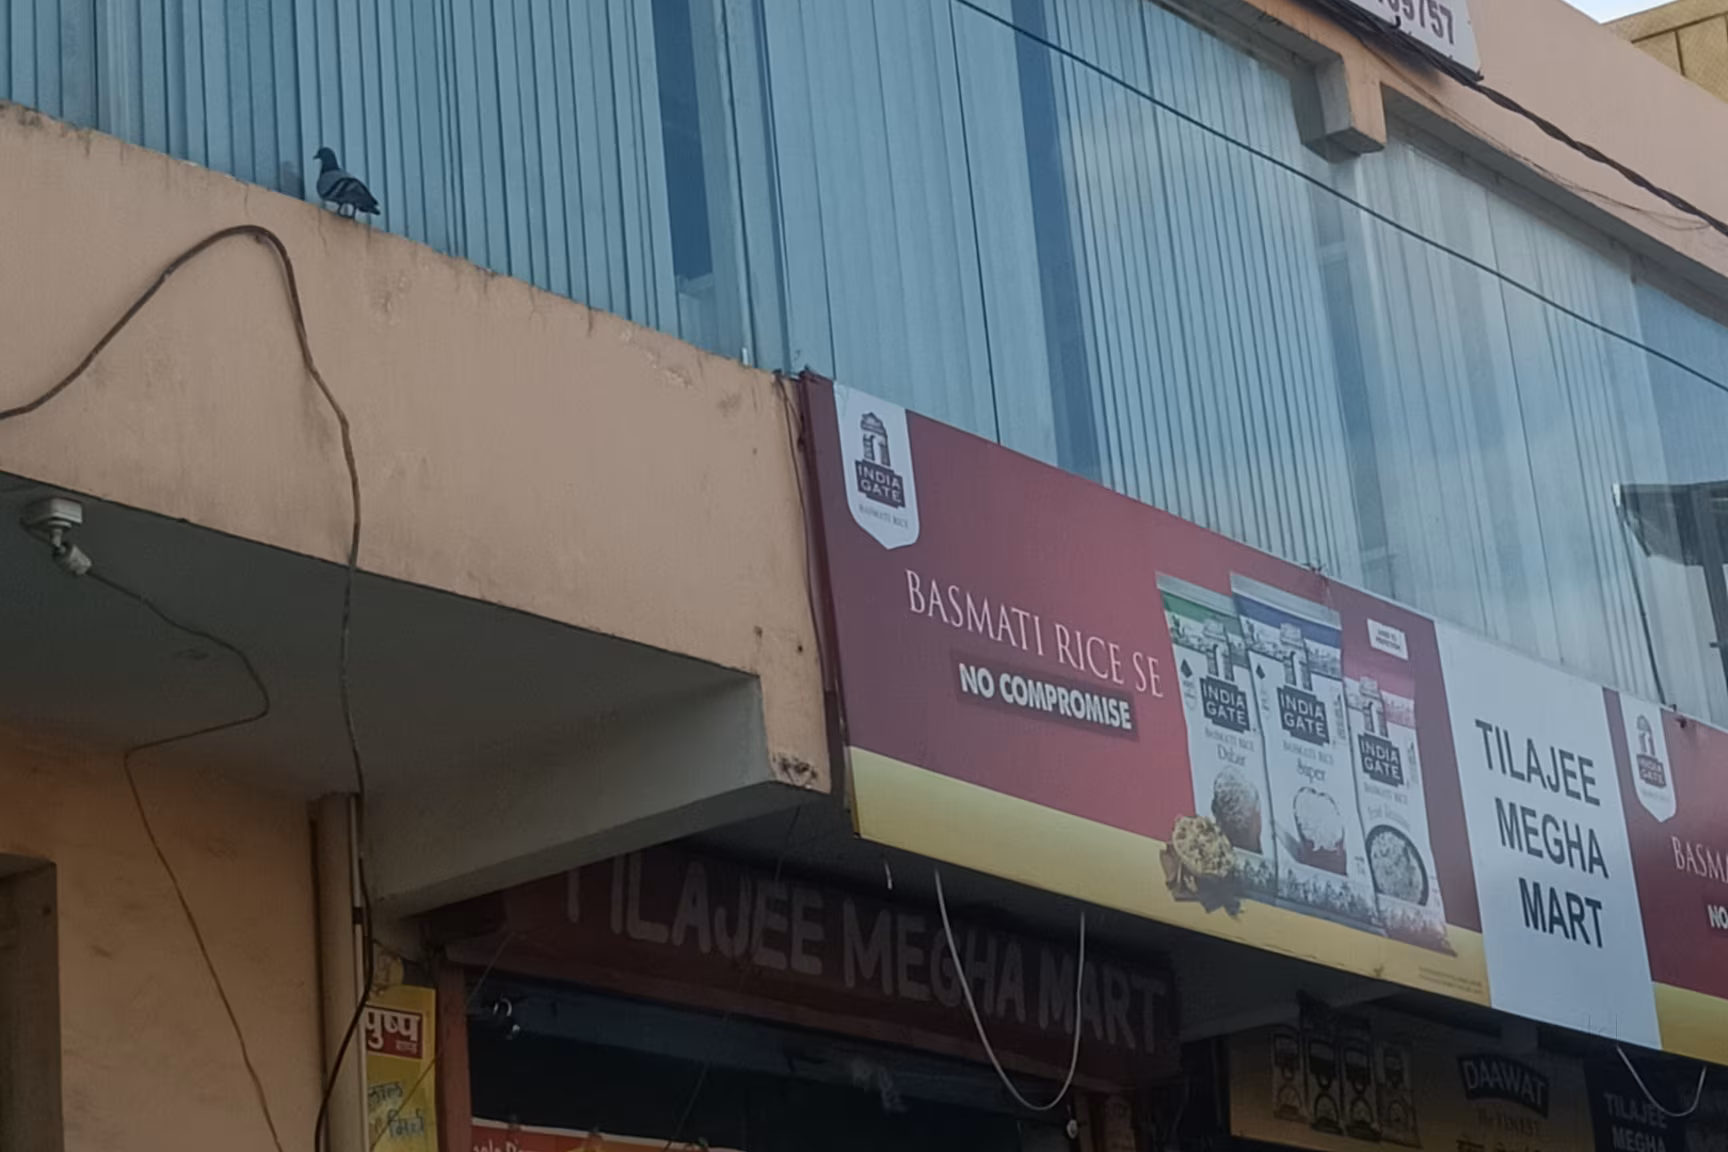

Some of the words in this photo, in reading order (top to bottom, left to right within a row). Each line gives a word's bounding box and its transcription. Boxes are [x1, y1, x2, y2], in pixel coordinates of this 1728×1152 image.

[858, 463, 901, 490] INDIA
[860, 479, 902, 504] GATE
[905, 569, 1046, 656] BASMATI
[1055, 623, 1125, 686] RICE
[1132, 651, 1163, 698] SE
[959, 663, 994, 699] NO
[999, 675, 1133, 731] COMPROMISE
[1203, 683, 1247, 711] INDIA
[1206, 700, 1249, 727] GATE
[1281, 694, 1325, 722] INDIA
[1284, 711, 1327, 739] GATE
[1361, 739, 1401, 765] INDIA
[1475, 718, 1602, 807] TILAJEE
[1364, 756, 1402, 782] GATE
[1494, 797, 1610, 880] MEGHA
[1518, 877, 1604, 950] MART
[842, 896, 1024, 1024] MEGHA
[1036, 944, 1166, 1054] MART
[1462, 1059, 1546, 1106] DAAWAT
[1603, 1091, 1668, 1130] TILAJEE
